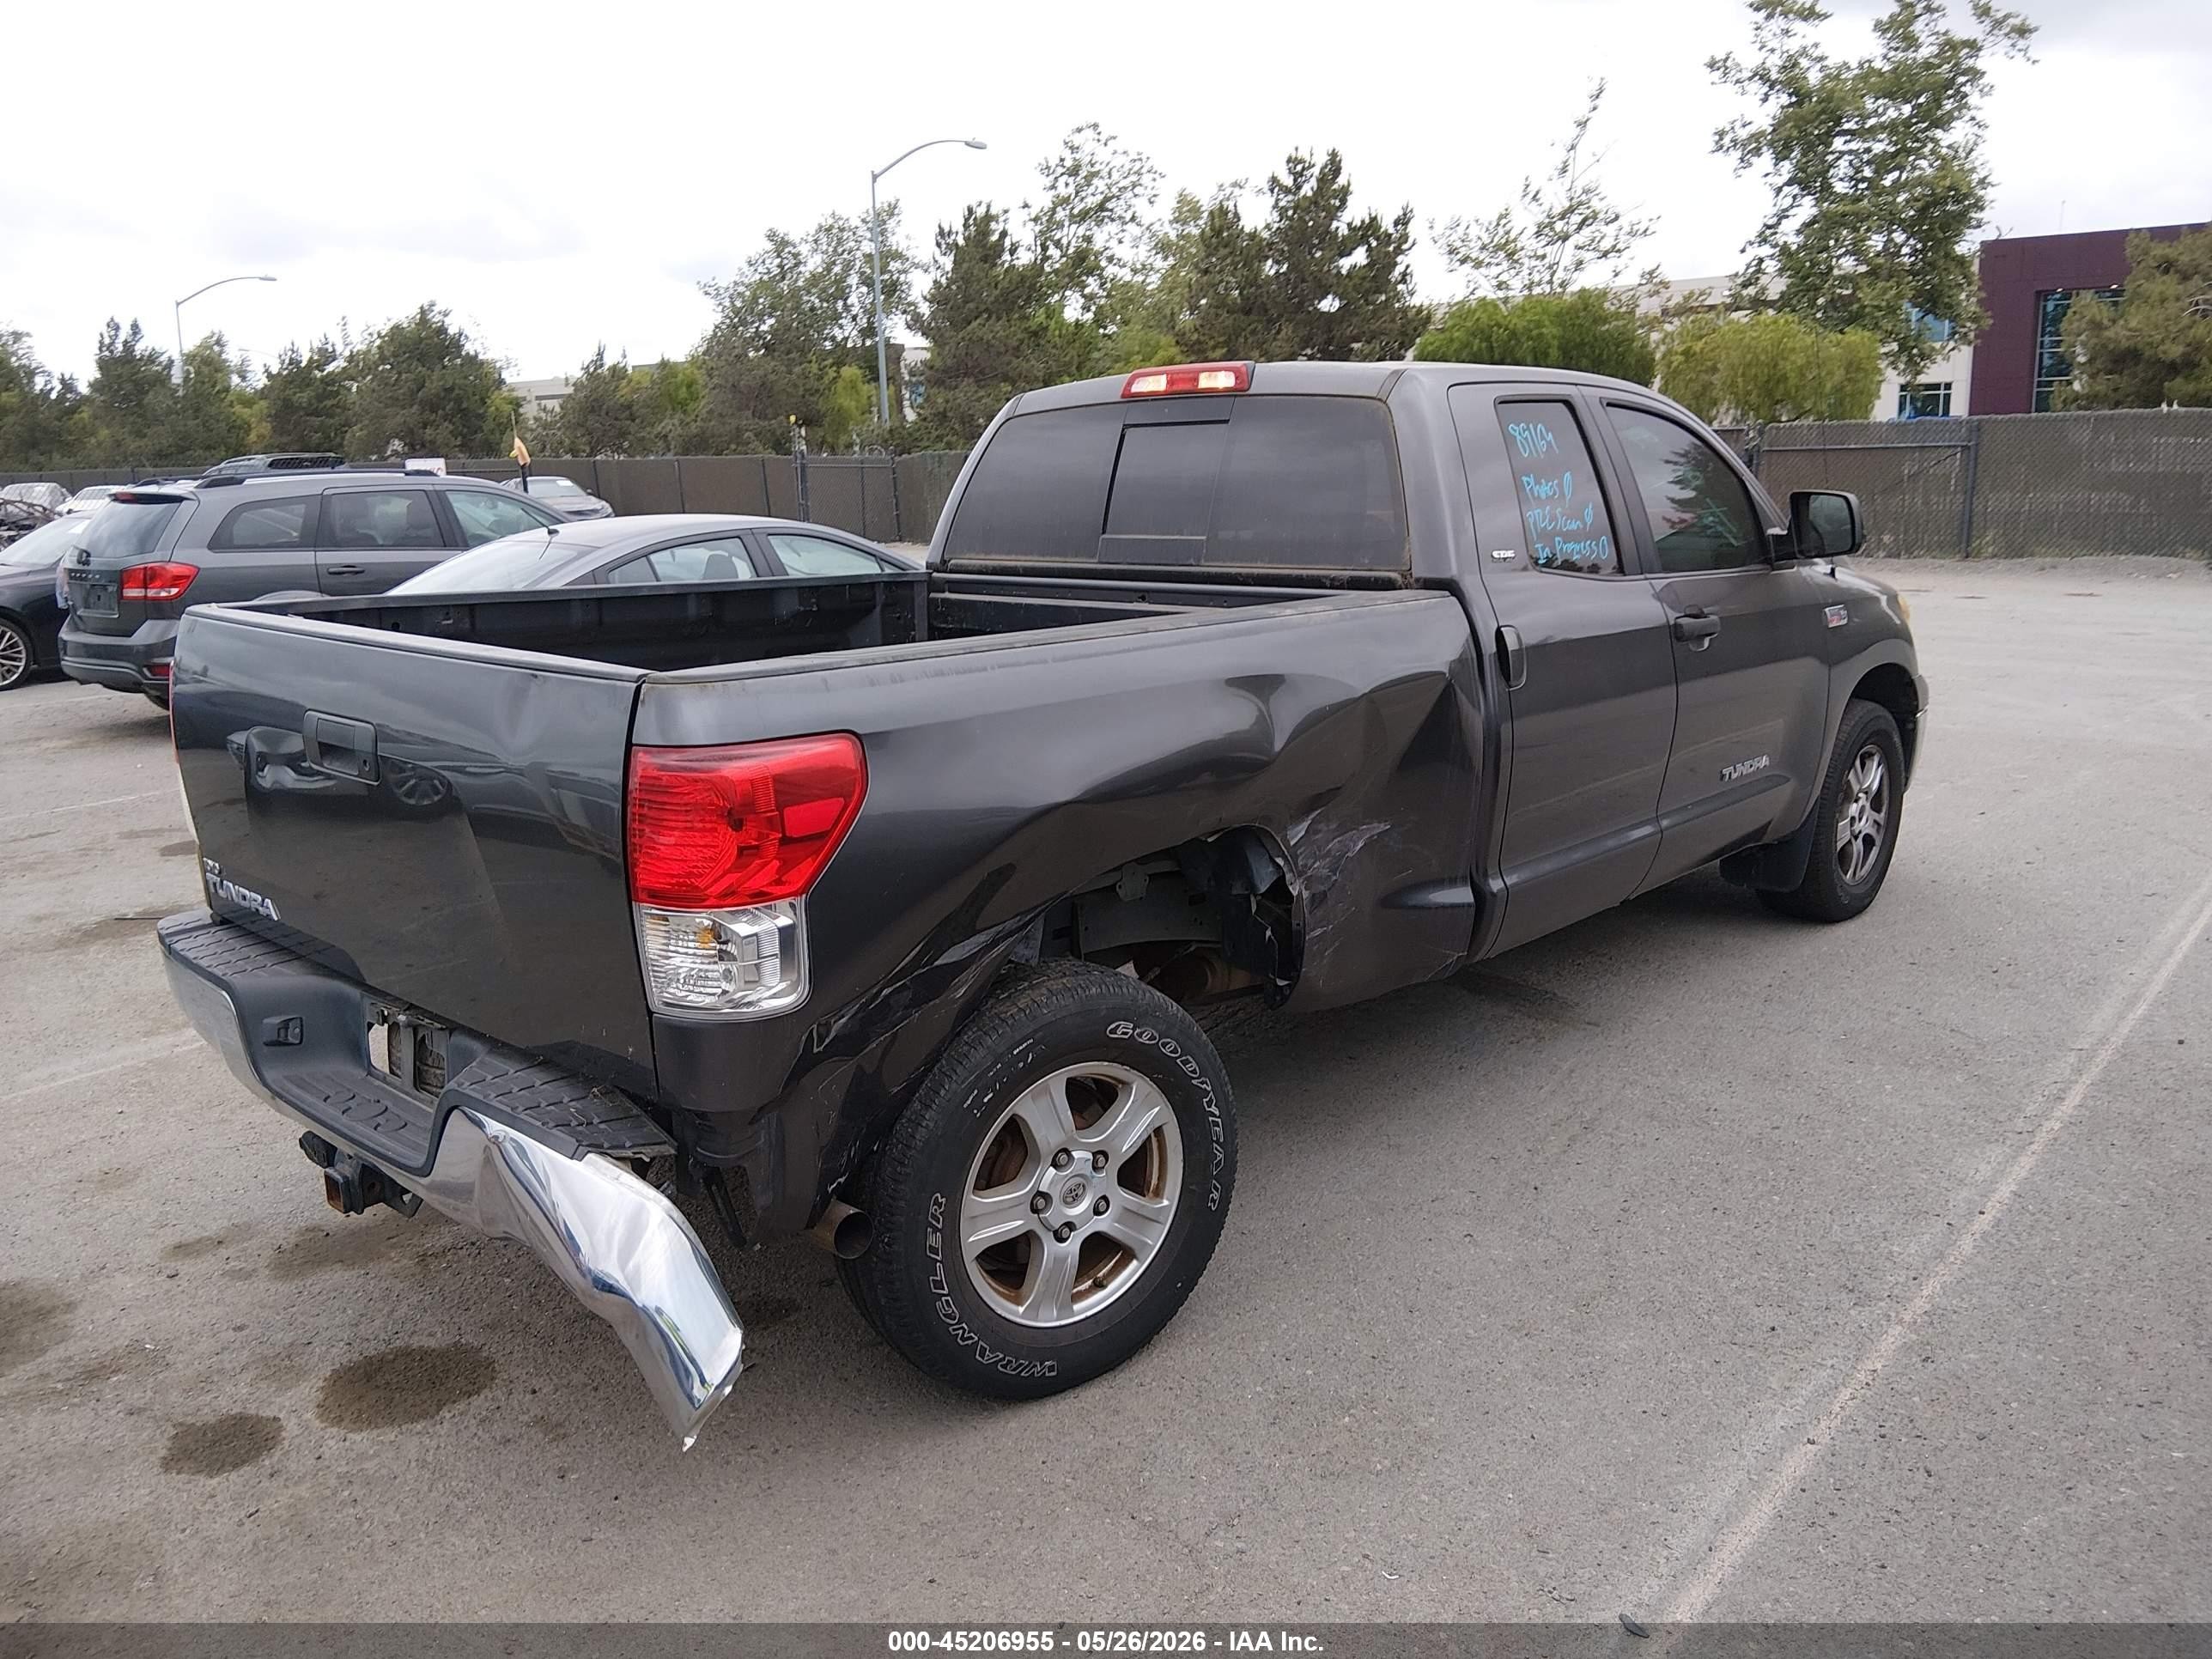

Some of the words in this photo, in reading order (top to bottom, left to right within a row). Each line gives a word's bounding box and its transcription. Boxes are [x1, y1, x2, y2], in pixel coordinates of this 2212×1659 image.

[1534, 543, 1553, 564] In
[1720, 754, 1770, 782] TUNDRA
[205, 872, 279, 921] TUNDRA
[1106, 1021, 1224, 1212] GOODYEAR
[927, 1192, 1059, 1377] WRANGLER
